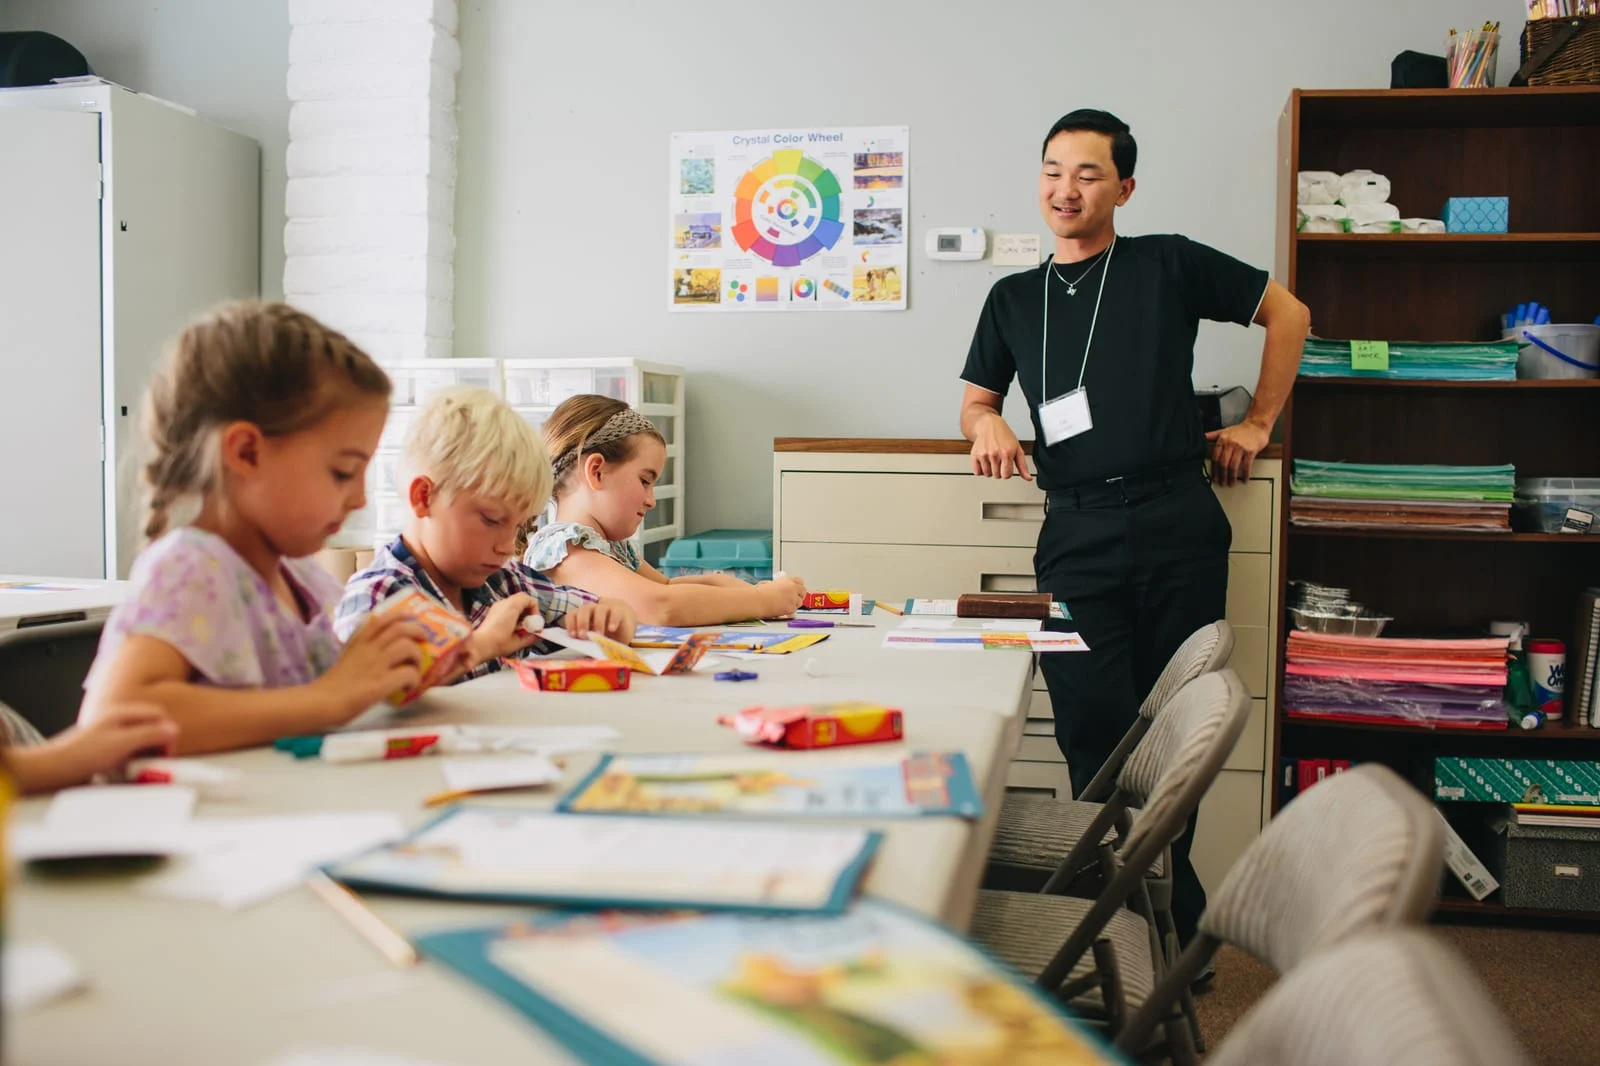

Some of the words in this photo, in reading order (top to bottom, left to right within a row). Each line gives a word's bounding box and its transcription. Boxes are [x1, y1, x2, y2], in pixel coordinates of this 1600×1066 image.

[732, 135, 770, 147] Crystal
[773, 133, 804, 143] Color
[807, 132, 843, 142] Wheel
